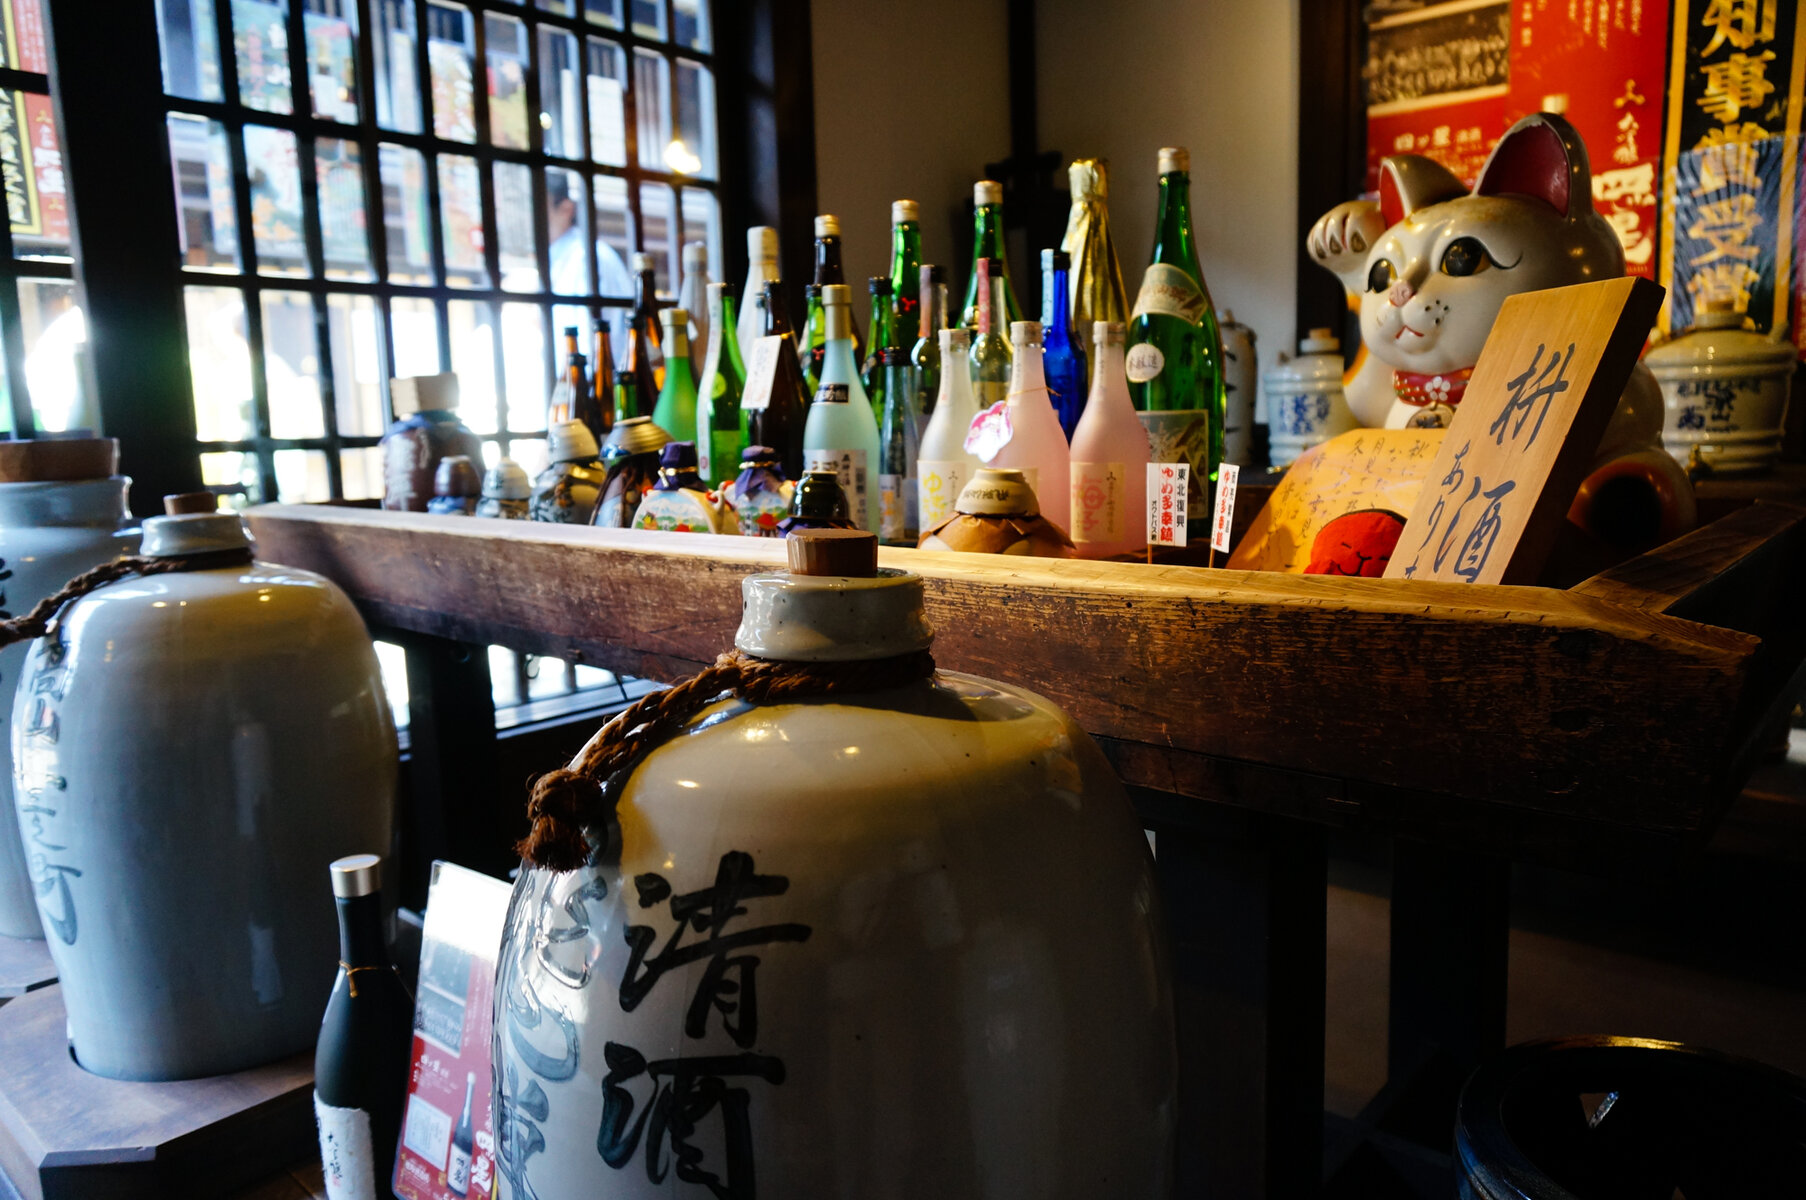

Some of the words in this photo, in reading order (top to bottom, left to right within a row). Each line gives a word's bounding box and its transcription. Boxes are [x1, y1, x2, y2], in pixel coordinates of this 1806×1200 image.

[1176, 468, 1187, 528] 東北復興
[597, 850, 813, 1200] 清酒
